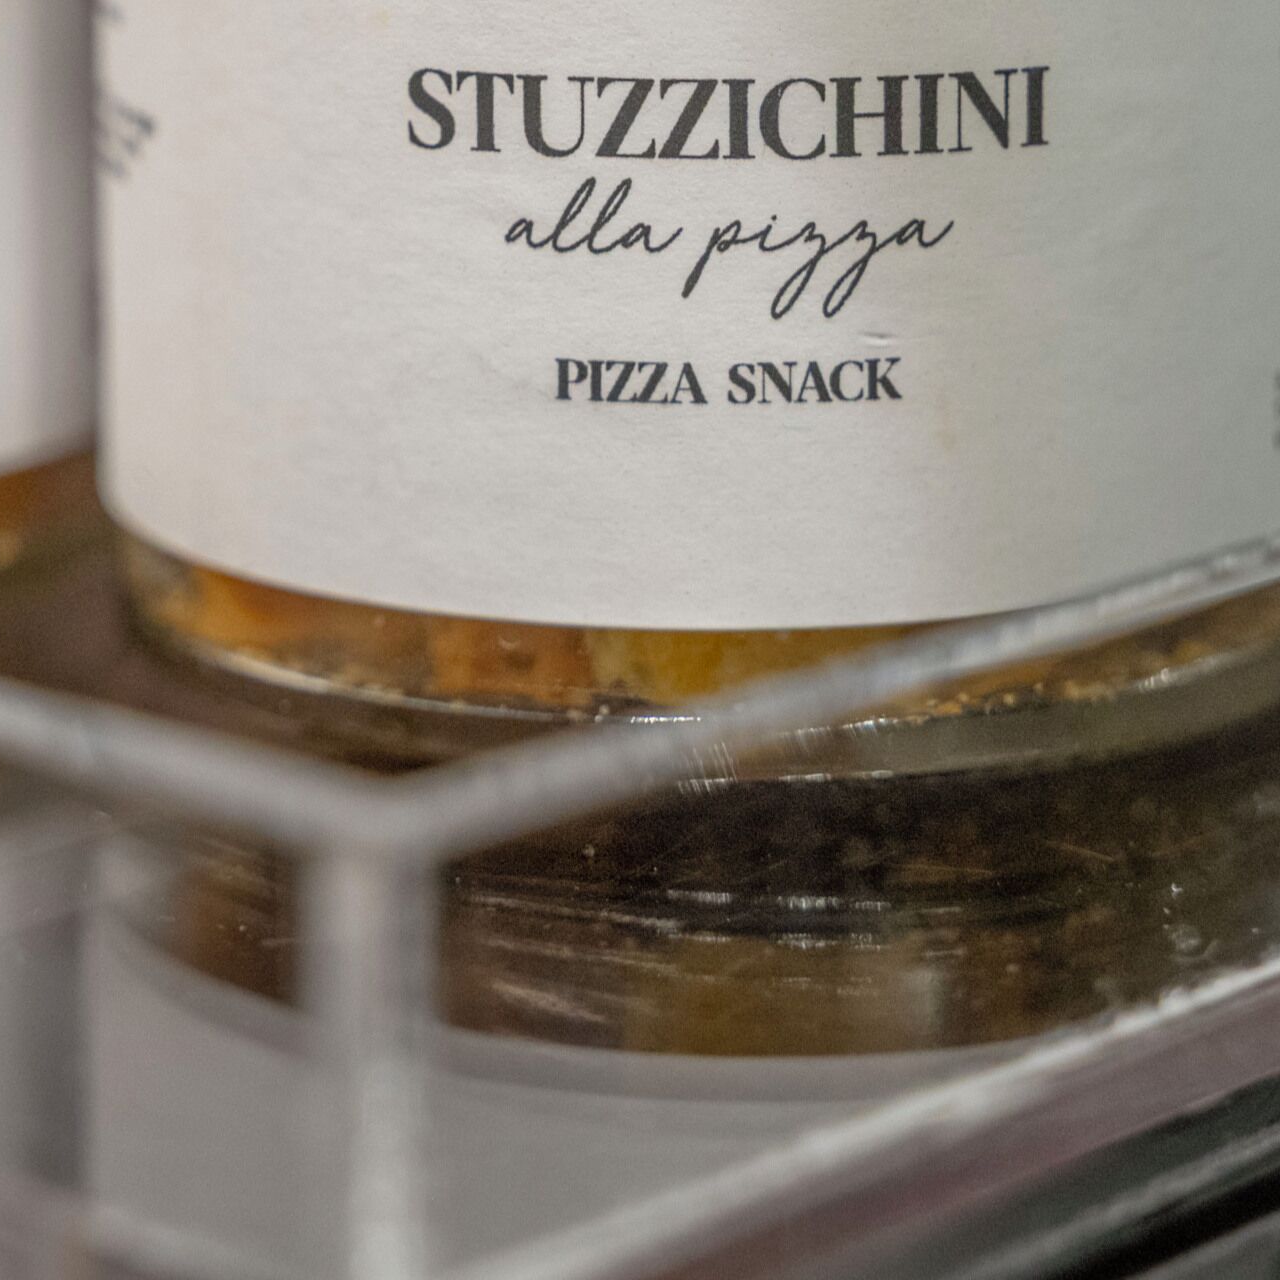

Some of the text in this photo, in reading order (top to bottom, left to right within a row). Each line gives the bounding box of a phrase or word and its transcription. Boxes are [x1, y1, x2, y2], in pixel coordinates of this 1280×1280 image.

[406, 65, 1051, 161] STUZZICHINI
[504, 176, 956, 320] alla pizza
[554, 357, 903, 405] PIZZA SNACK
